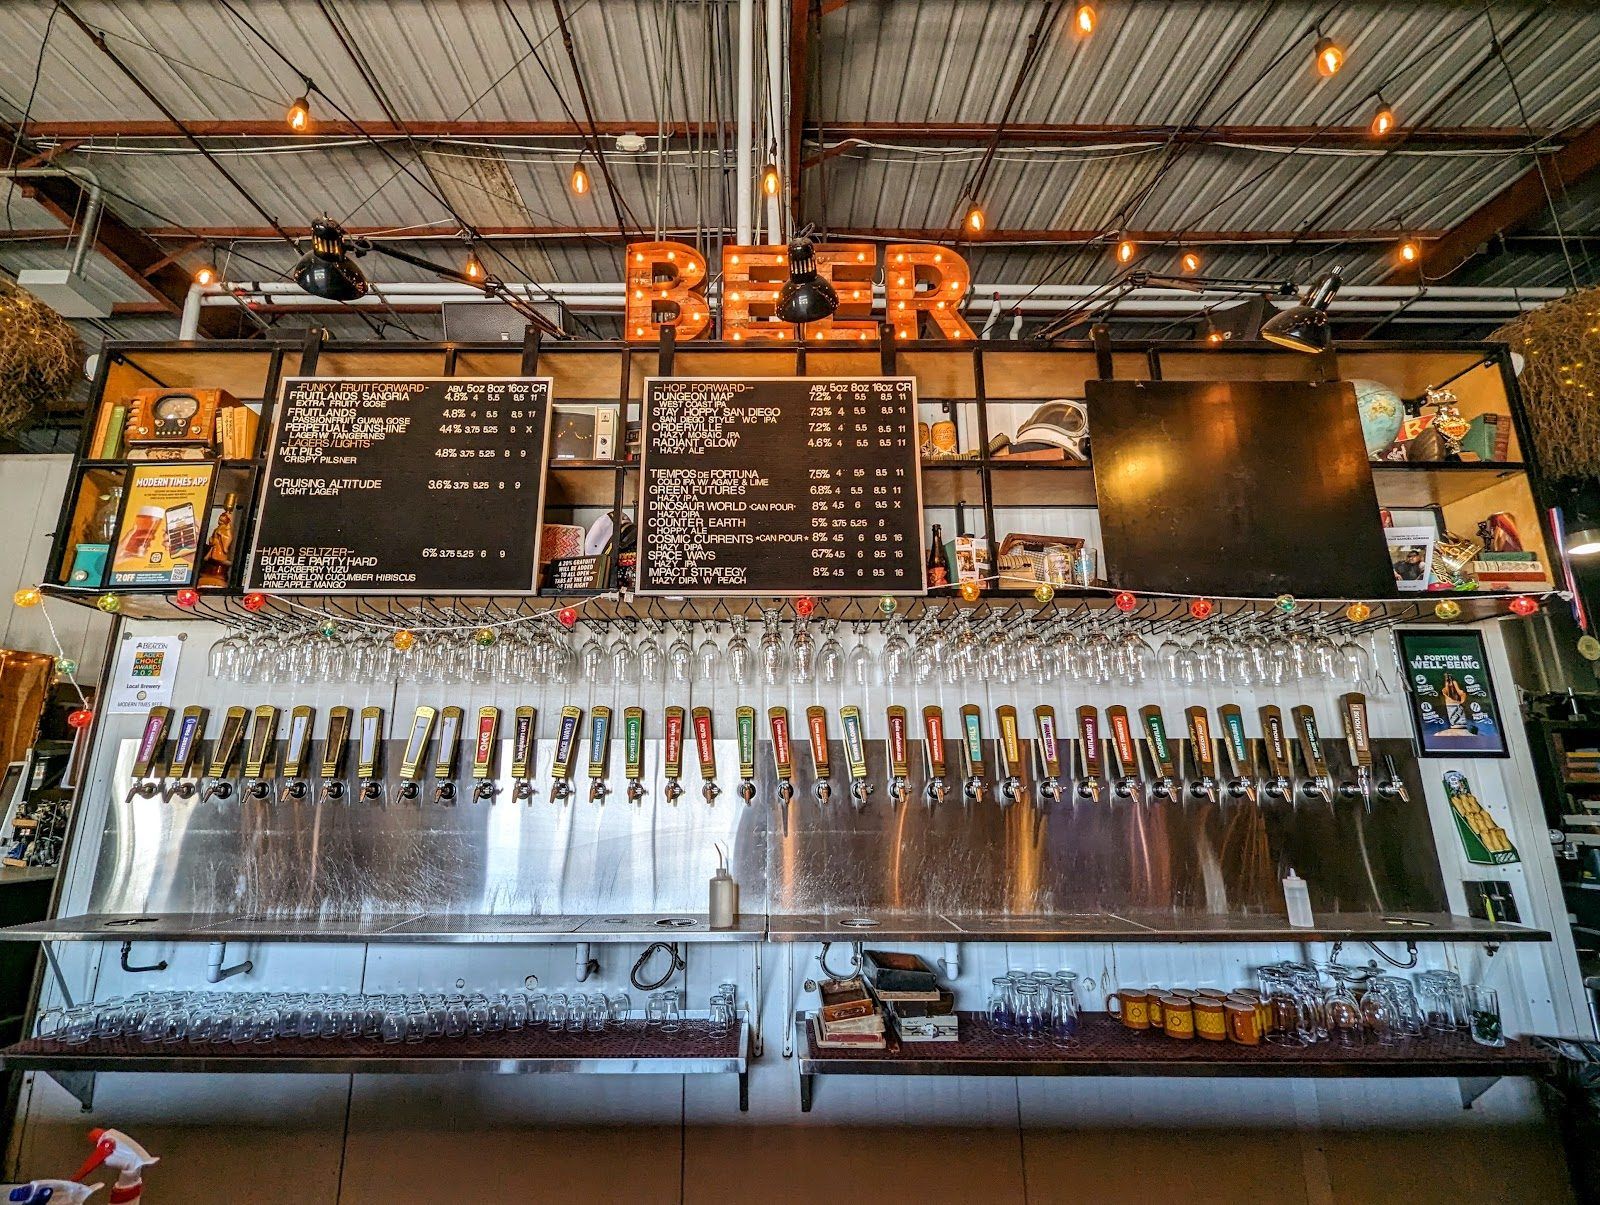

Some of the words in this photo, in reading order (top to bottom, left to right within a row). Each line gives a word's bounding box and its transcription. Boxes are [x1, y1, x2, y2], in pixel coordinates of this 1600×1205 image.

[625, 241, 977, 340] BEER
[340, 384, 370, 392] FRUIT
[290, 391, 358, 400] FRUITLANDS
[362, 392, 410, 400] SANGRIA
[654, 392, 706, 400] DUNGEON
[711, 392, 734, 400] MAP
[287, 408, 356, 416] FRUITLANDS
[653, 408, 678, 416] STAY
[684, 408, 719, 416] HOPPY
[723, 408, 744, 416] SAN
[748, 408, 780, 416] DIEGO
[292, 416, 355, 424] PASSIONFRUIT
[285, 423, 348, 432] PERPETUAL
[352, 424, 406, 433] SUNSHINE
[652, 423, 722, 432] ORDERVILLE
[652, 438, 700, 446] RADIANT
[704, 438, 737, 447] GLOW
[300, 447, 322, 456] PILS
[650, 469, 696, 478] TIEMPOS
[710, 470, 759, 478] FORTUNA
[136, 478, 169, 488] MODERN
[170, 478, 192, 487] TIMES
[192, 477, 208, 486] APP
[274, 478, 325, 488] CRUISING
[329, 479, 382, 489] ALTITUDE
[649, 486, 688, 494] GREEN
[692, 486, 746, 495] FUTURES
[650, 502, 704, 511] DINOSAUR
[706, 502, 746, 511] WORLD
[648, 518, 704, 527] COUNTER
[709, 518, 746, 527] EARTH
[648, 534, 690, 544] COSMIC
[694, 534, 754, 544] CURRENTS
[648, 550, 682, 560] SPACE
[687, 550, 716, 560] WAYS
[261, 556, 306, 566] BUBBLE
[308, 557, 345, 566] PARTY
[347, 558, 378, 566] HARD
[649, 568, 688, 576] IMPACT
[690, 568, 746, 577] STRATEGY
[123, 574, 136, 582] OFF
[1411, 660, 1480, 670] WELL-BEING
[480, 732, 490, 750] OMG
